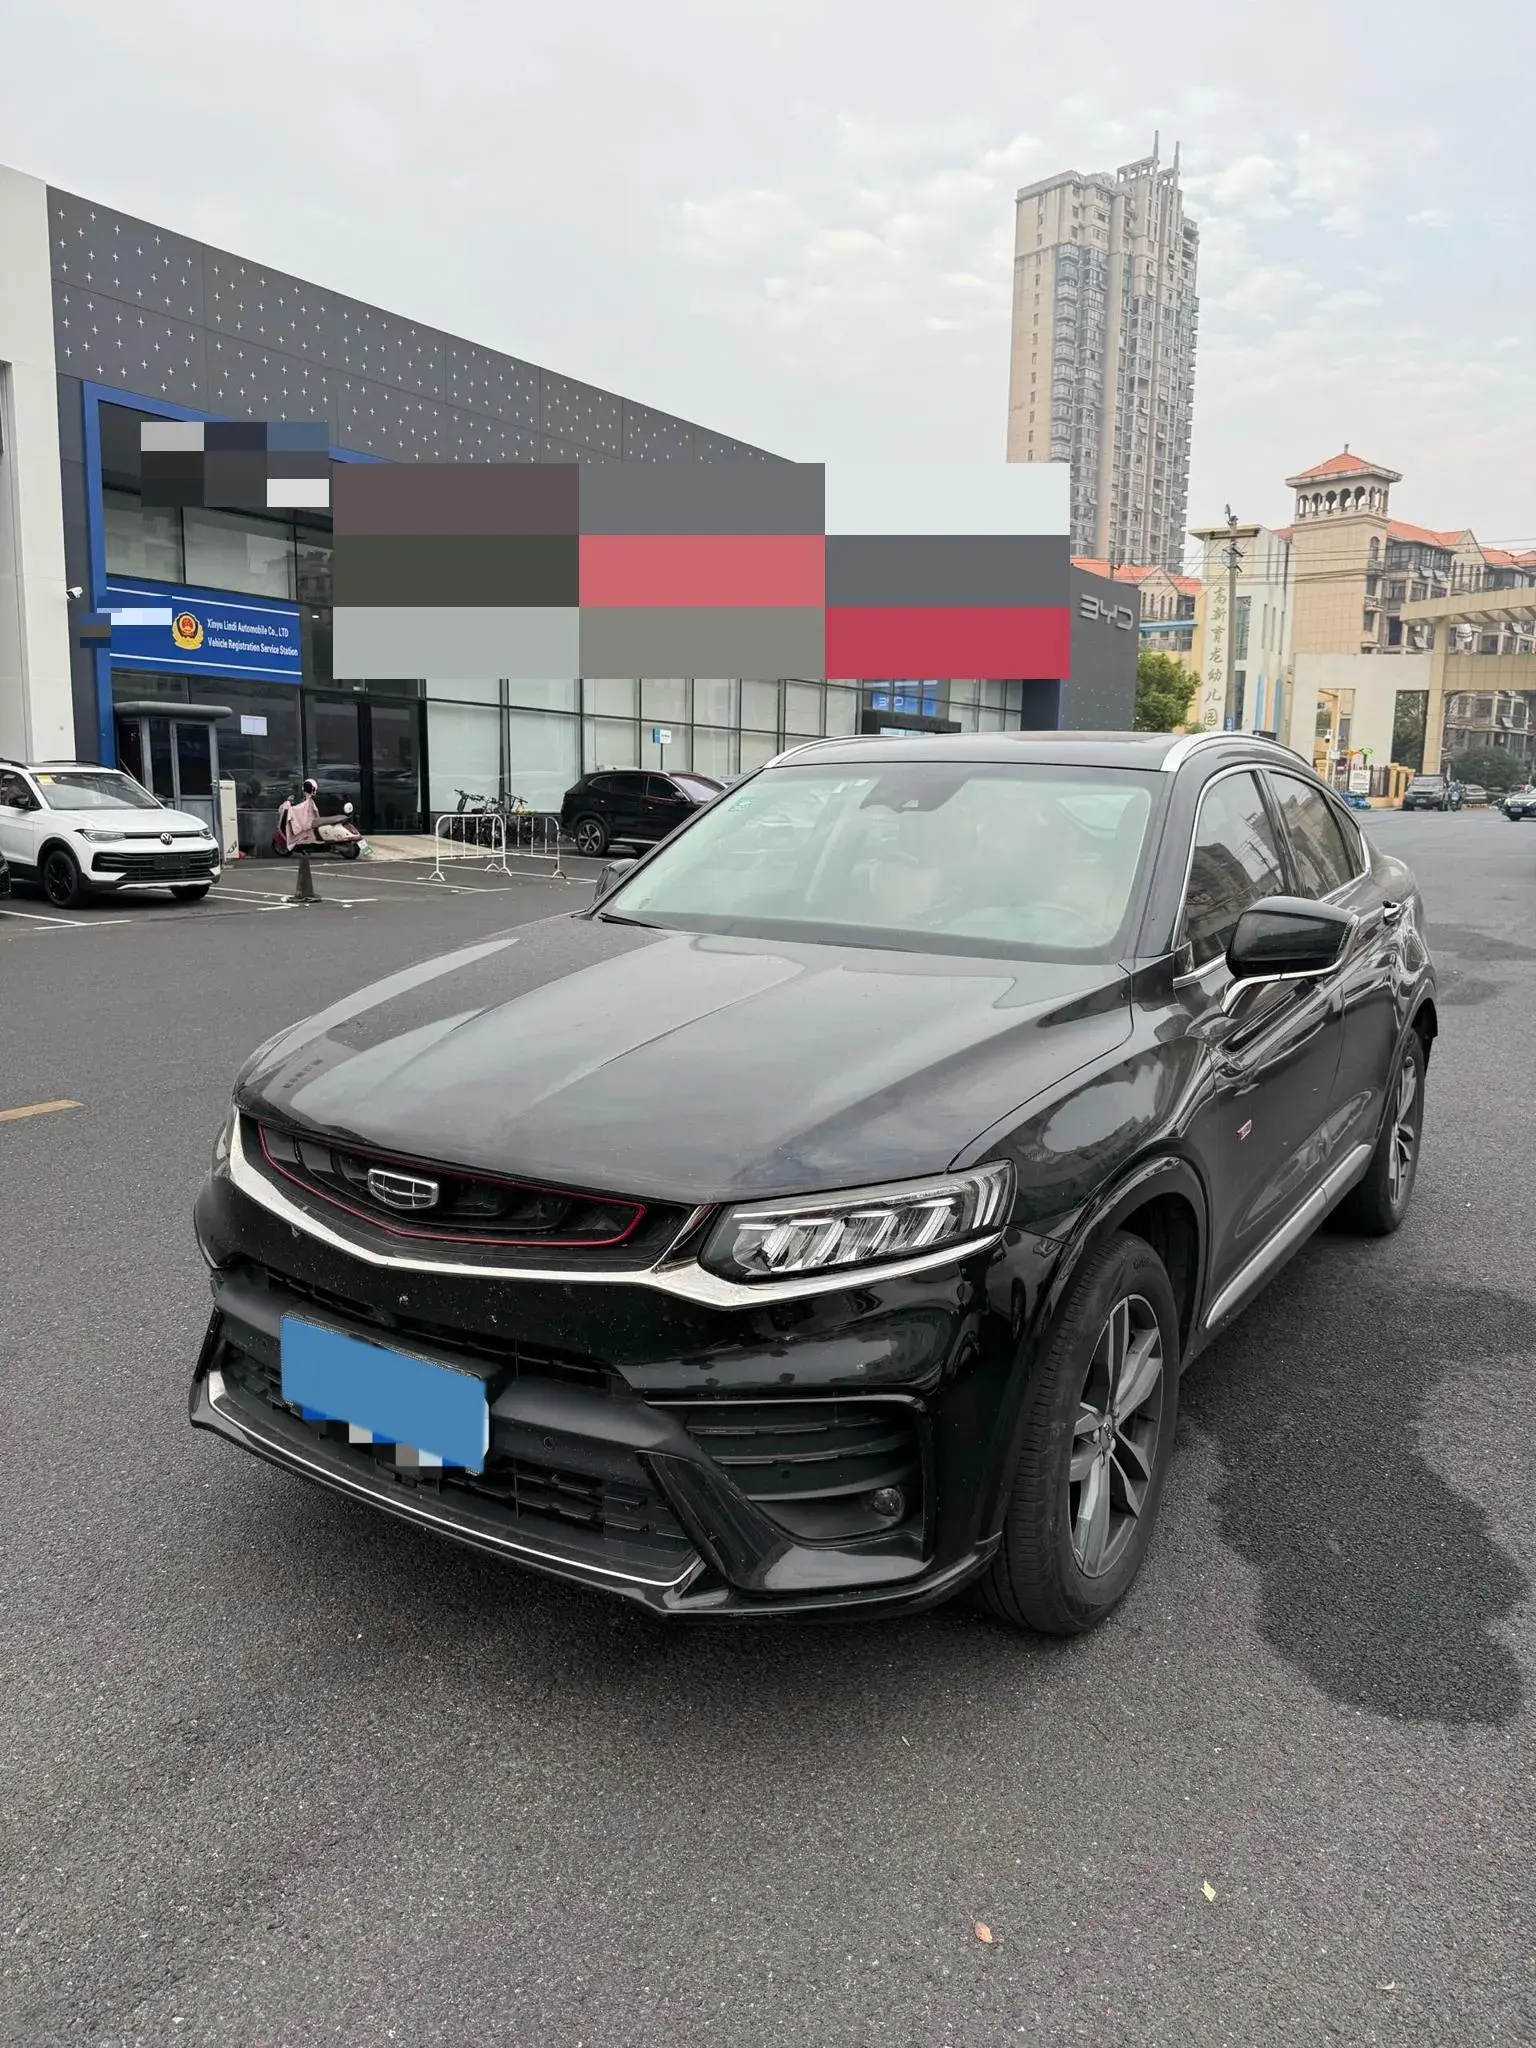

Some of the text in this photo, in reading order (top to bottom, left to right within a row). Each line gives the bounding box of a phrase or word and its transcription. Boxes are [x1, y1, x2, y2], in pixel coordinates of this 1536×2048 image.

[1080, 594, 1133, 630] BYD
[207, 618, 223, 631] Xinyu
[224, 620, 237, 631] Lindi
[238, 621, 267, 635] Automobile
[279, 626, 289, 638] LTD
[207, 636, 299, 656] Vehicle Registration Service Station
